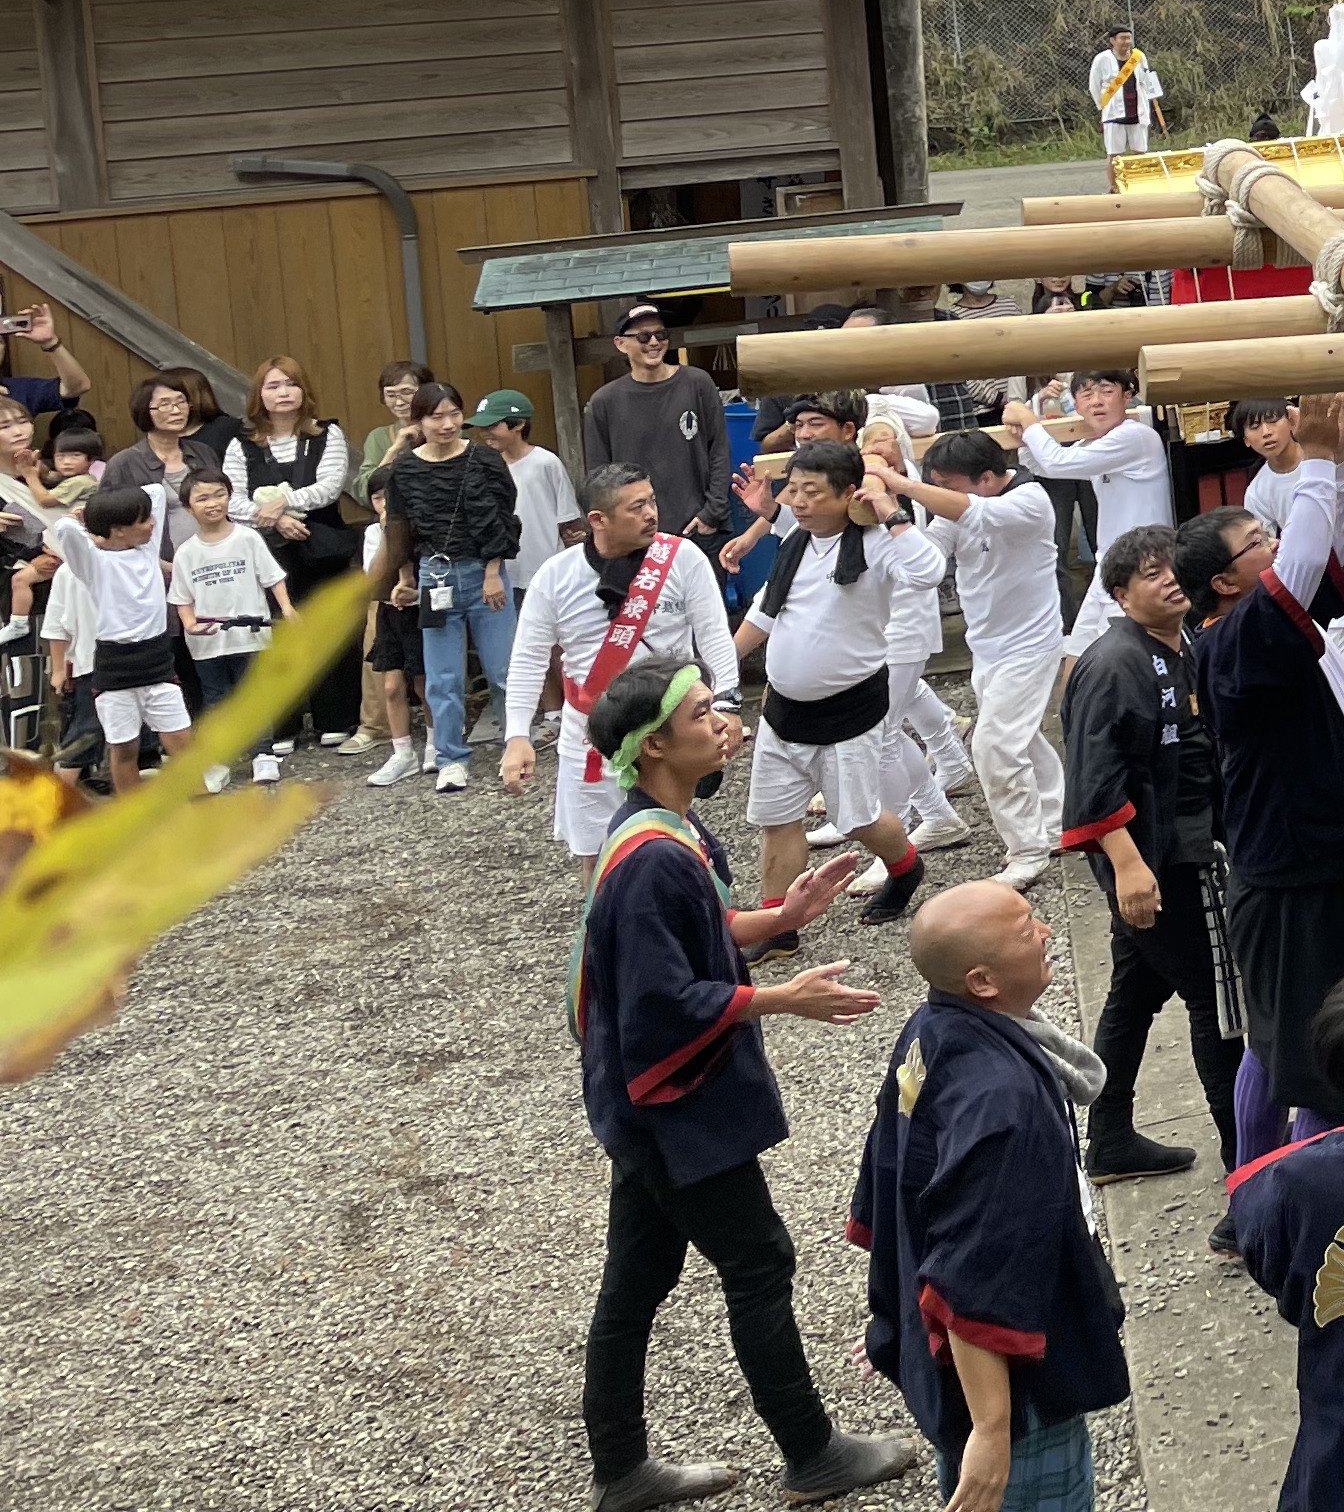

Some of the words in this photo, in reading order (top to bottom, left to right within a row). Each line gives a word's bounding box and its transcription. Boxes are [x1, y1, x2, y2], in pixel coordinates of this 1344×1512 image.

[192, 560, 246, 576] METROPOLITAN
[193, 572, 221, 584] MUSEUM
[234, 567, 246, 575] ART
[219, 576, 235, 584] YORK
